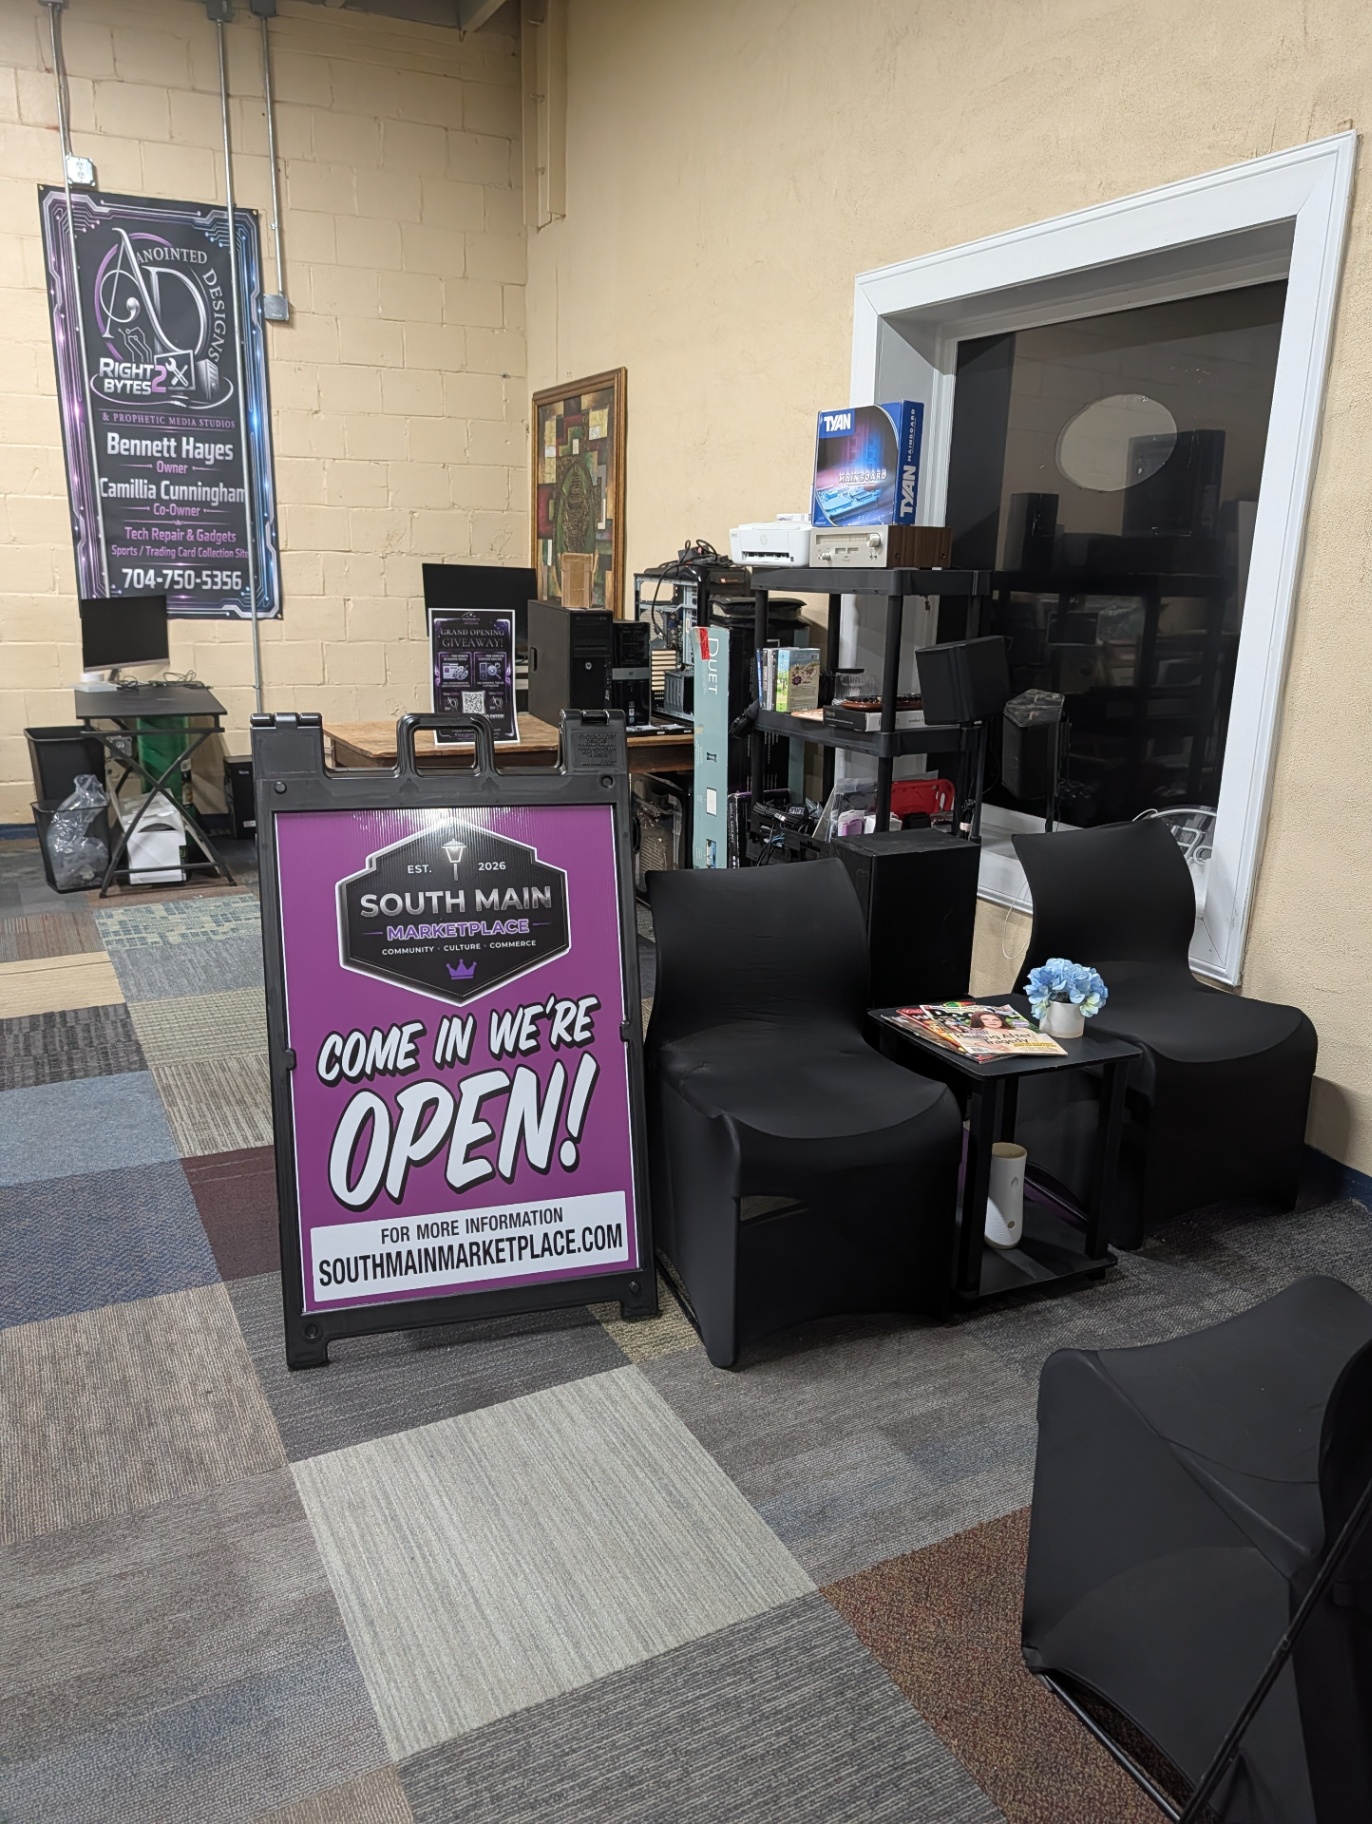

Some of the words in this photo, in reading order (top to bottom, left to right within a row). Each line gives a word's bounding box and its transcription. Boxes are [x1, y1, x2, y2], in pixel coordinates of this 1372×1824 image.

[202, 268, 227, 362] DESIGNS
[99, 357, 154, 379] RIGHT
[104, 378, 152, 395] BYTES
[102, 412, 109, 421] &
[113, 413, 165, 424] PROPHETIC
[168, 417, 197, 426] MEDIA
[199, 419, 236, 428] STUDIOS
[823, 413, 851, 432] TYAN
[907, 408, 916, 462] MAINBOARD
[107, 432, 177, 459] Bennett
[182, 437, 233, 465] Hayes
[156, 461, 188, 474] Owner
[838, 469, 887, 484] MAINBOARD
[100, 478, 157, 499] Camillia
[160, 481, 246, 506] Cunningham
[900, 465, 917, 518] TYAN
[153, 503, 200, 517] Co-Owner
[124, 527, 149, 541] Tech
[151, 528, 185, 544] Repair
[186, 529, 195, 541] &
[196, 529, 237, 545] Gadgets
[111, 545, 137, 556] Sports
[146, 546, 175, 559] Trading
[177, 547, 196, 558] Card
[197, 547, 234, 558] Collection
[121, 568, 242, 590] 704-750-5356
[442, 638, 504, 648] GIVEAWAY!
[707, 637, 719, 695] DUET
[407, 864, 432, 874] EST.
[478, 861, 506, 871] 2026
[360, 889, 466, 918] SOUTH
[475, 885, 552, 912] MAIN
[386, 918, 530, 941] MARKETPLACE
[382, 946, 434, 956] COMMUNITY
[443, 943, 481, 952] CULTURE
[489, 940, 537, 949] COMMERCE
[317, 1022, 426, 1085] COME
[434, 1014, 475, 1067] IN
[489, 996, 600, 1056] WE'RE
[329, 1052, 598, 1210] OPEN!
[380, 1226, 410, 1244] FOR
[416, 1219, 459, 1240] MORE
[465, 1207, 564, 1234] INFORMATION
[318, 1223, 623, 1287] SOUTHMAINMARKETPLACE.COM
